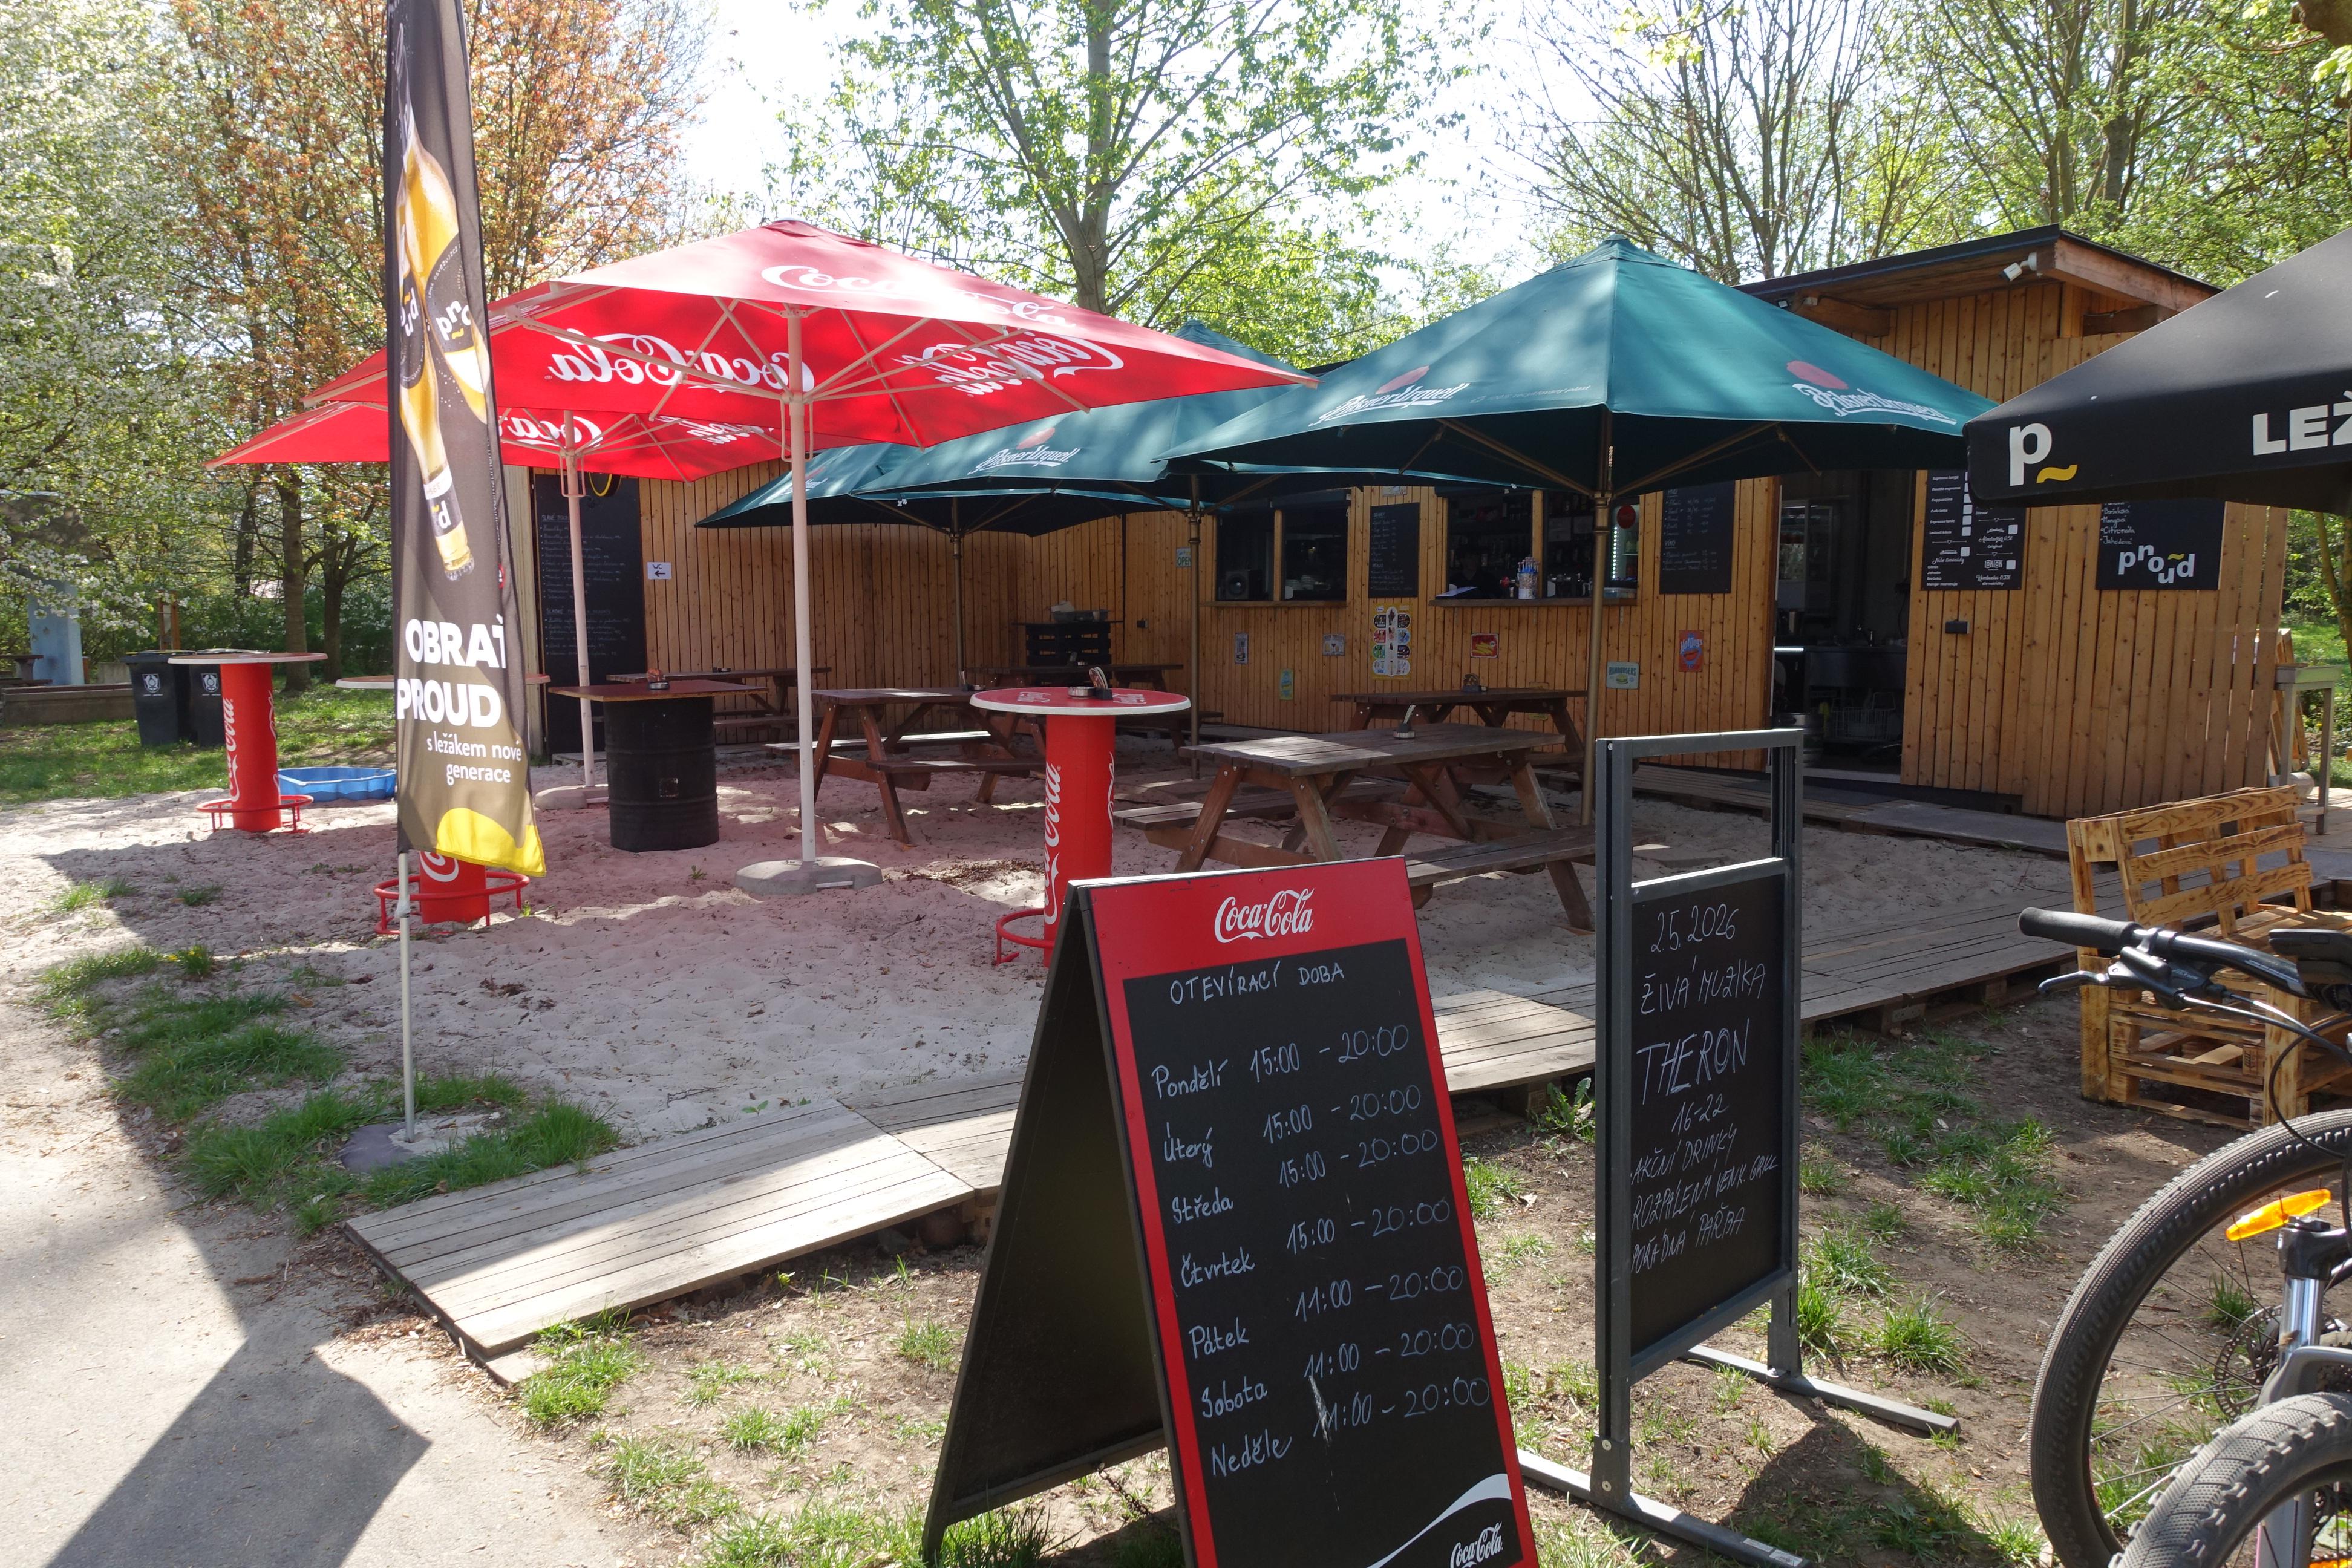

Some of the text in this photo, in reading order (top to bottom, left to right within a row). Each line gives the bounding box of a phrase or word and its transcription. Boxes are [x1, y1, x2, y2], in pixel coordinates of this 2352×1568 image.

[2118, 544, 2195, 584] proud
[397, 678, 502, 728] PROUD
[426, 730, 522, 762] s ležákem nové
[446, 760, 511, 786] generace
[1214, 887, 1315, 944] Coca-Cola
[1170, 959, 1345, 1005] OTEVÍRACÍ DOBA
[1698, 958, 1766, 1005] MUZIKA
[1151, 1059, 1229, 1099] Pondělí
[1250, 1042, 1301, 1083] 15:00
[1636, 1018, 1750, 1106] THERON
[1164, 1122, 1213, 1168] Úterý
[1263, 1105, 1312, 1144] 15:00
[1671, 1092, 1729, 1134] 16-22
[1682, 1122, 1737, 1171] DRINKY
[1172, 1187, 1234, 1224] Středa
[1279, 1151, 1326, 1188] 15:00
[1181, 1247, 1255, 1288] Čtvrtek
[1287, 1218, 1335, 1255] 15:00
[1189, 1317, 1249, 1359] Pátek
[1295, 1279, 1352, 1322] 11:00
[1201, 1376, 1268, 1418] Sobota
[1304, 1342, 1360, 1379] 11:00
[1211, 1429, 1293, 1477] Neděle
[1450, 1521, 1504, 1568] Coca-Cola
